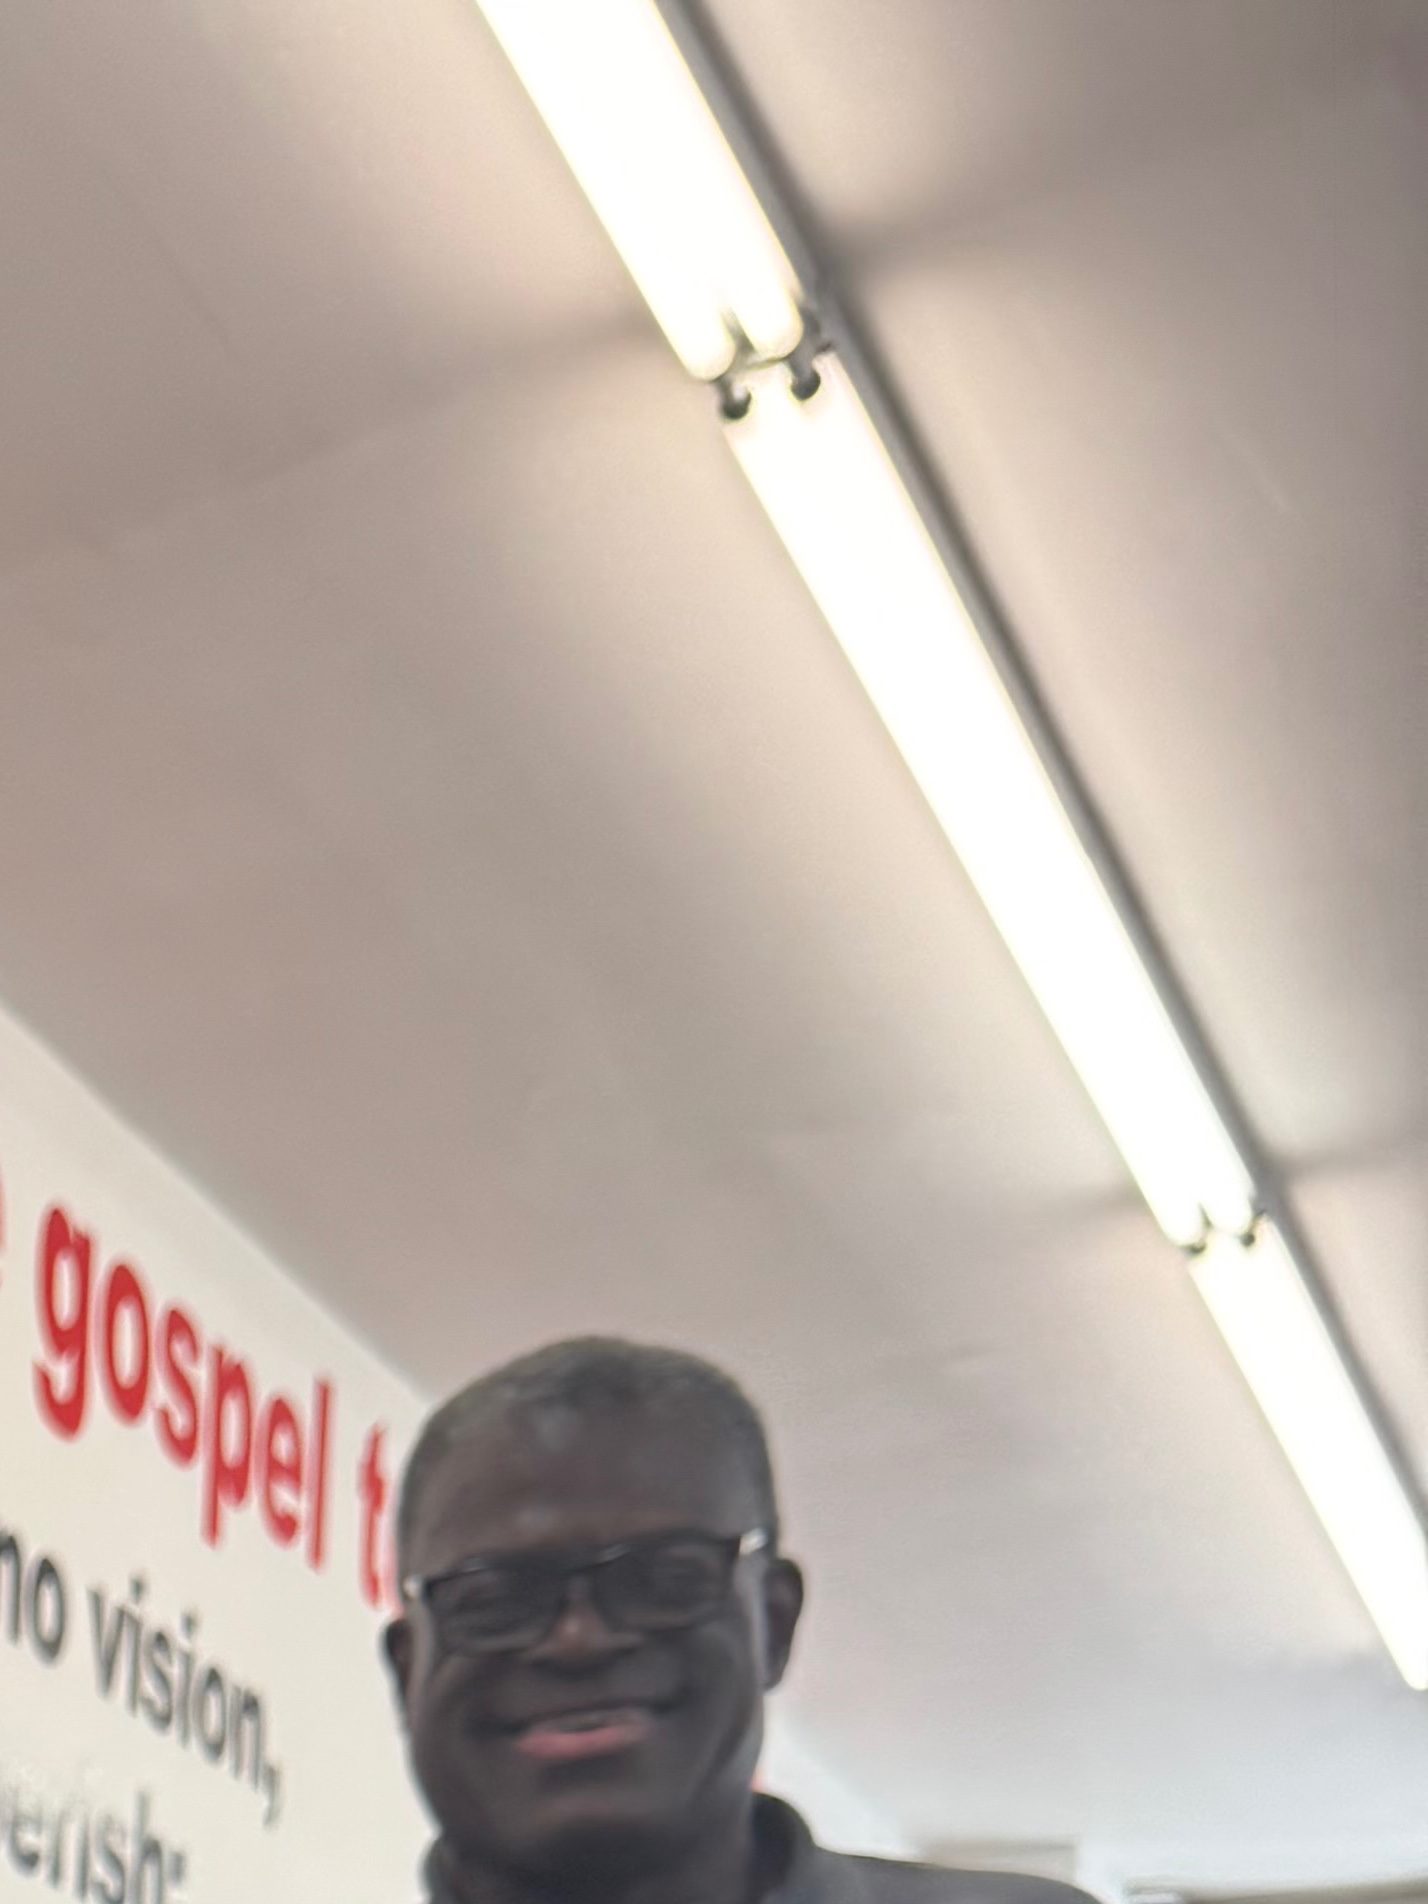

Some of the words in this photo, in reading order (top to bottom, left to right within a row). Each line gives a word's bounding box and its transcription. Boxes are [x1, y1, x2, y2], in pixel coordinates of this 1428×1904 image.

[32, 1207, 331, 1574] gospel
[356, 1423, 402, 1618] t
[88, 1572, 282, 1826] vision,
